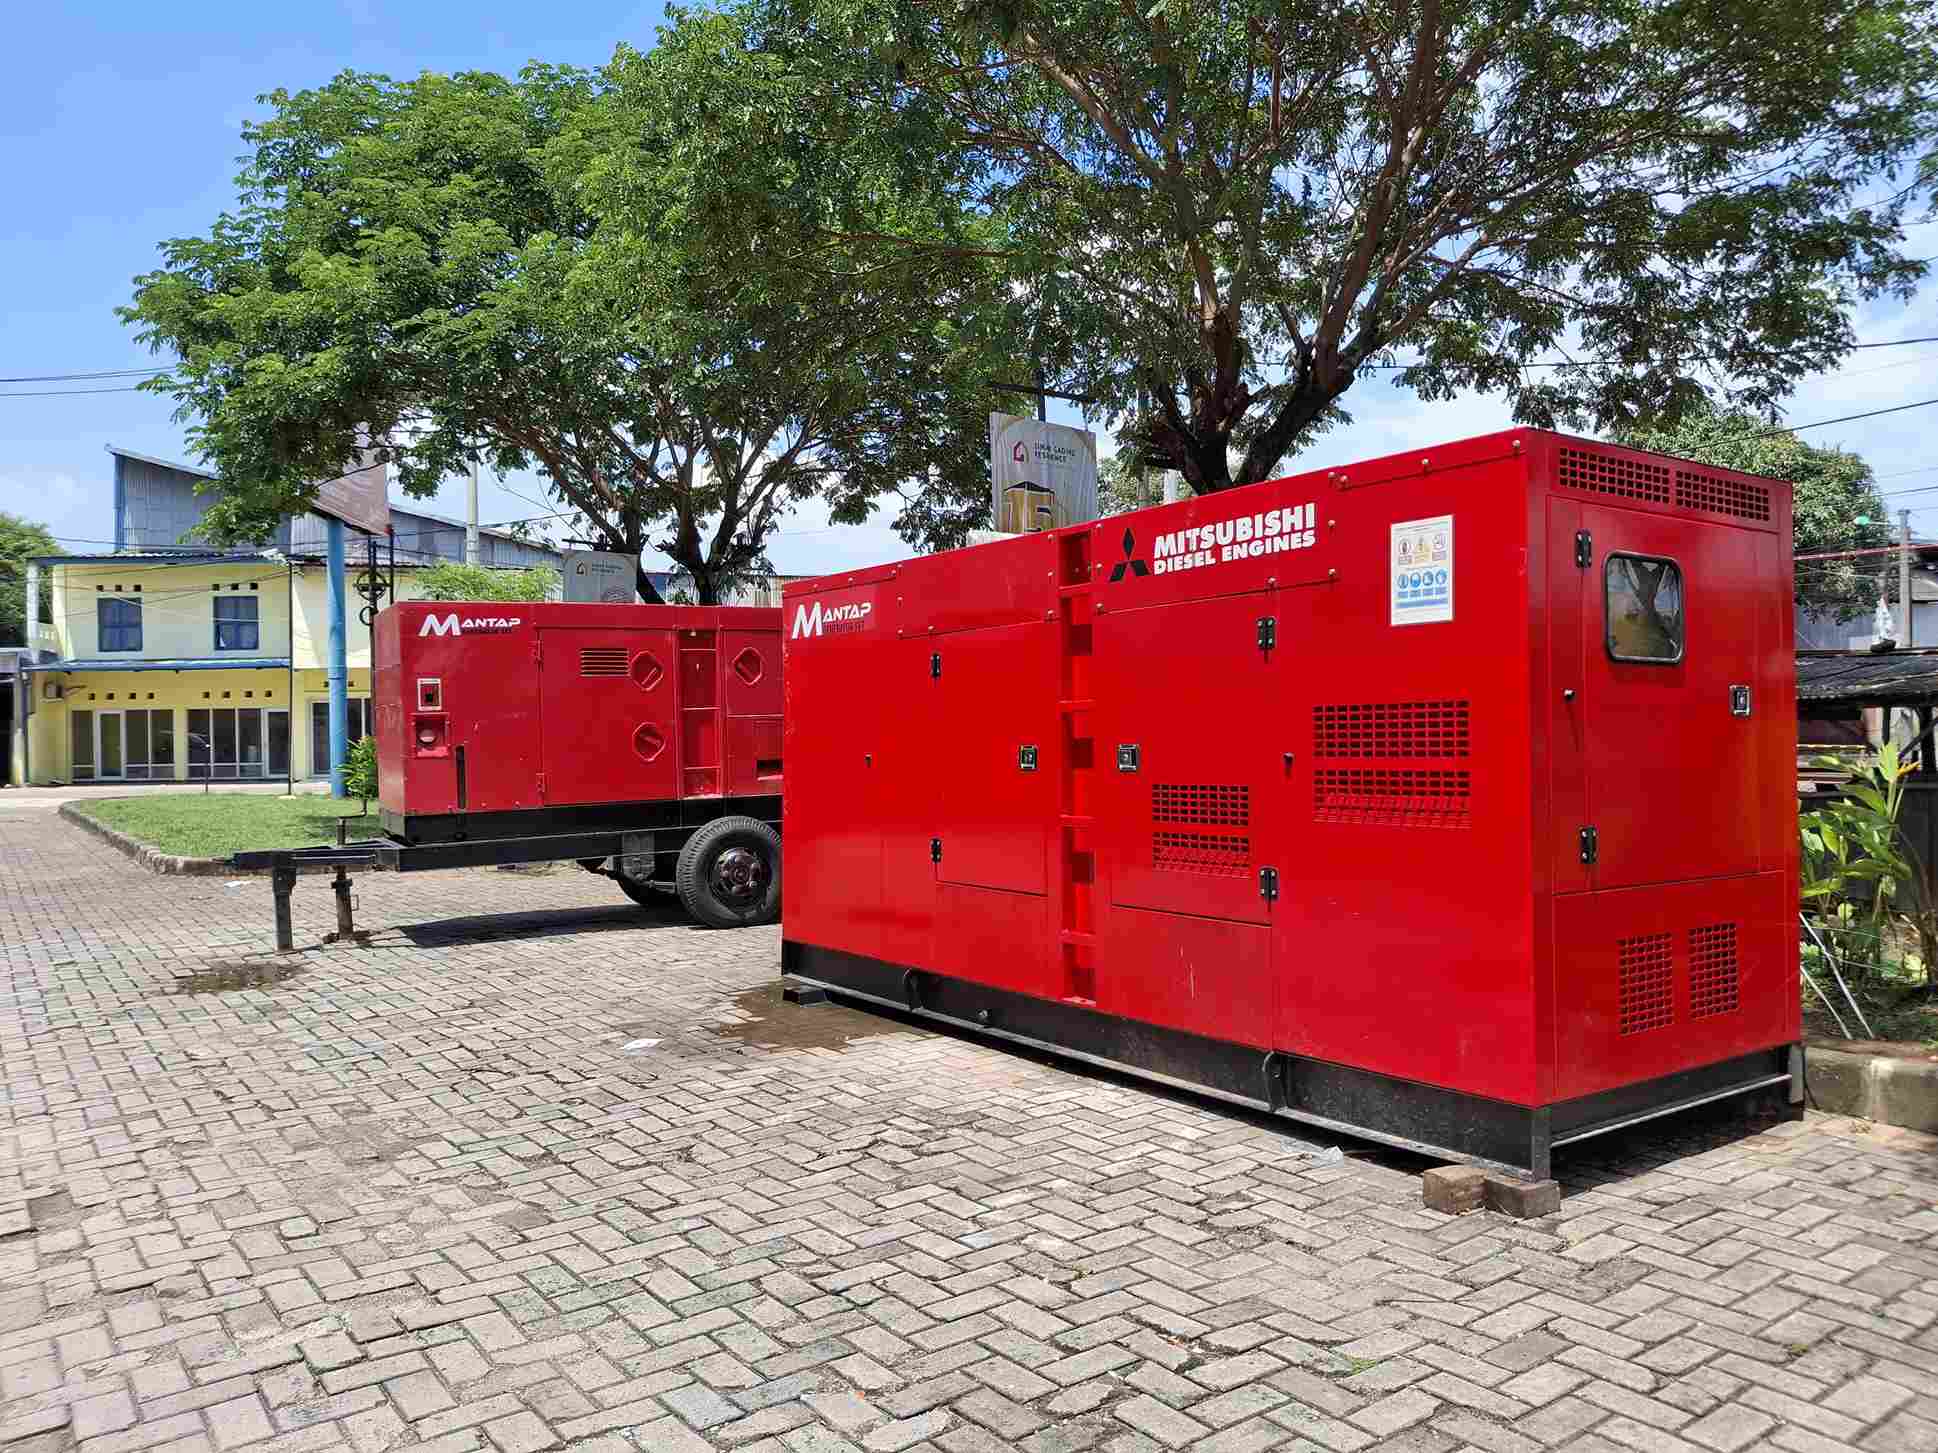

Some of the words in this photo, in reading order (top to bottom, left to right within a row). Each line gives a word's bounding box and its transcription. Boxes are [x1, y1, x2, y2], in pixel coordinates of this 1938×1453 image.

[1154, 502, 1315, 559] MITSUBISHI
[1154, 550, 1216, 575] DIESEL
[1222, 530, 1315, 562] ENGINES
